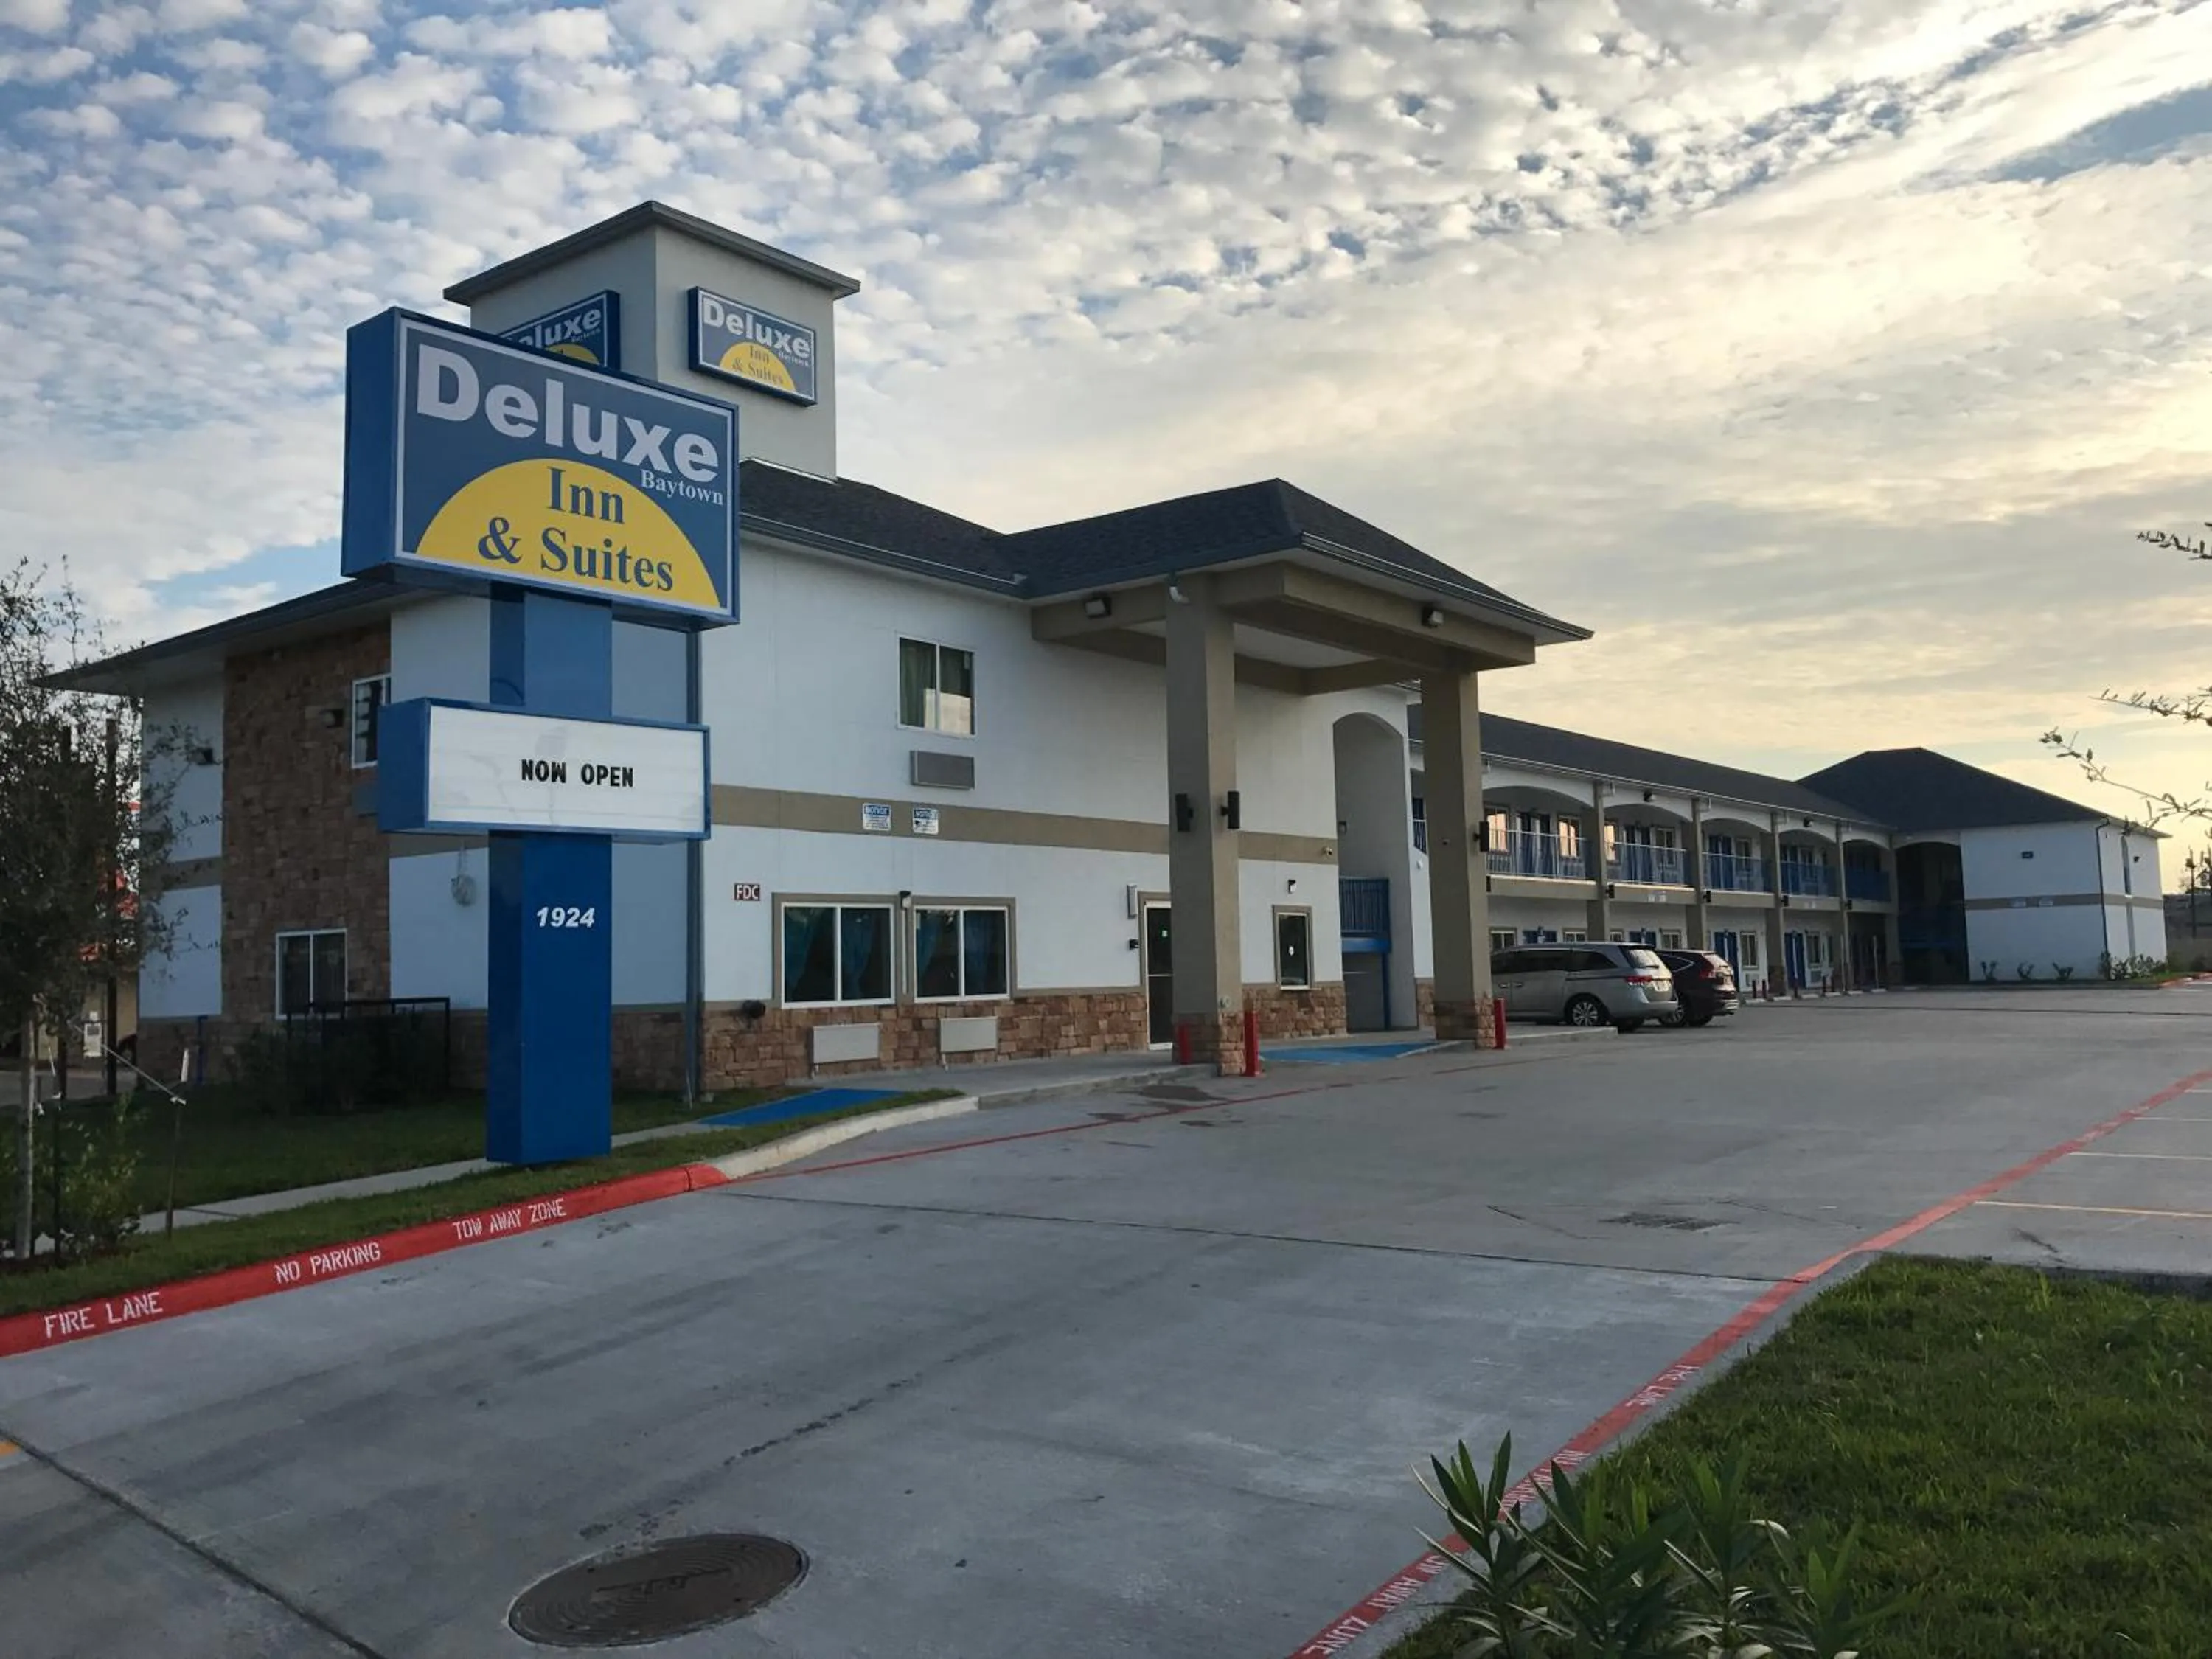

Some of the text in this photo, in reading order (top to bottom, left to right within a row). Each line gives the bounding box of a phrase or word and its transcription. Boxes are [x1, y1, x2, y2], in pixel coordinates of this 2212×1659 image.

[509, 308, 602, 349] luxe
[703, 297, 810, 359] Deluxe
[748, 362, 784, 385] Suites
[749, 344, 770, 364] Inn
[417, 343, 720, 483] Deluxe
[546, 466, 625, 525] Inn
[641, 469, 724, 506] Baytown
[477, 515, 673, 592] & Suites
[521, 759, 633, 787] NOW OPEN
[737, 884, 759, 900] FDC
[536, 906, 595, 928] 1924
[452, 1197, 567, 1240] TOW AWAY ZONE
[274, 1241, 381, 1284] NO PARKING
[44, 1291, 164, 1339] FIRE LANE
